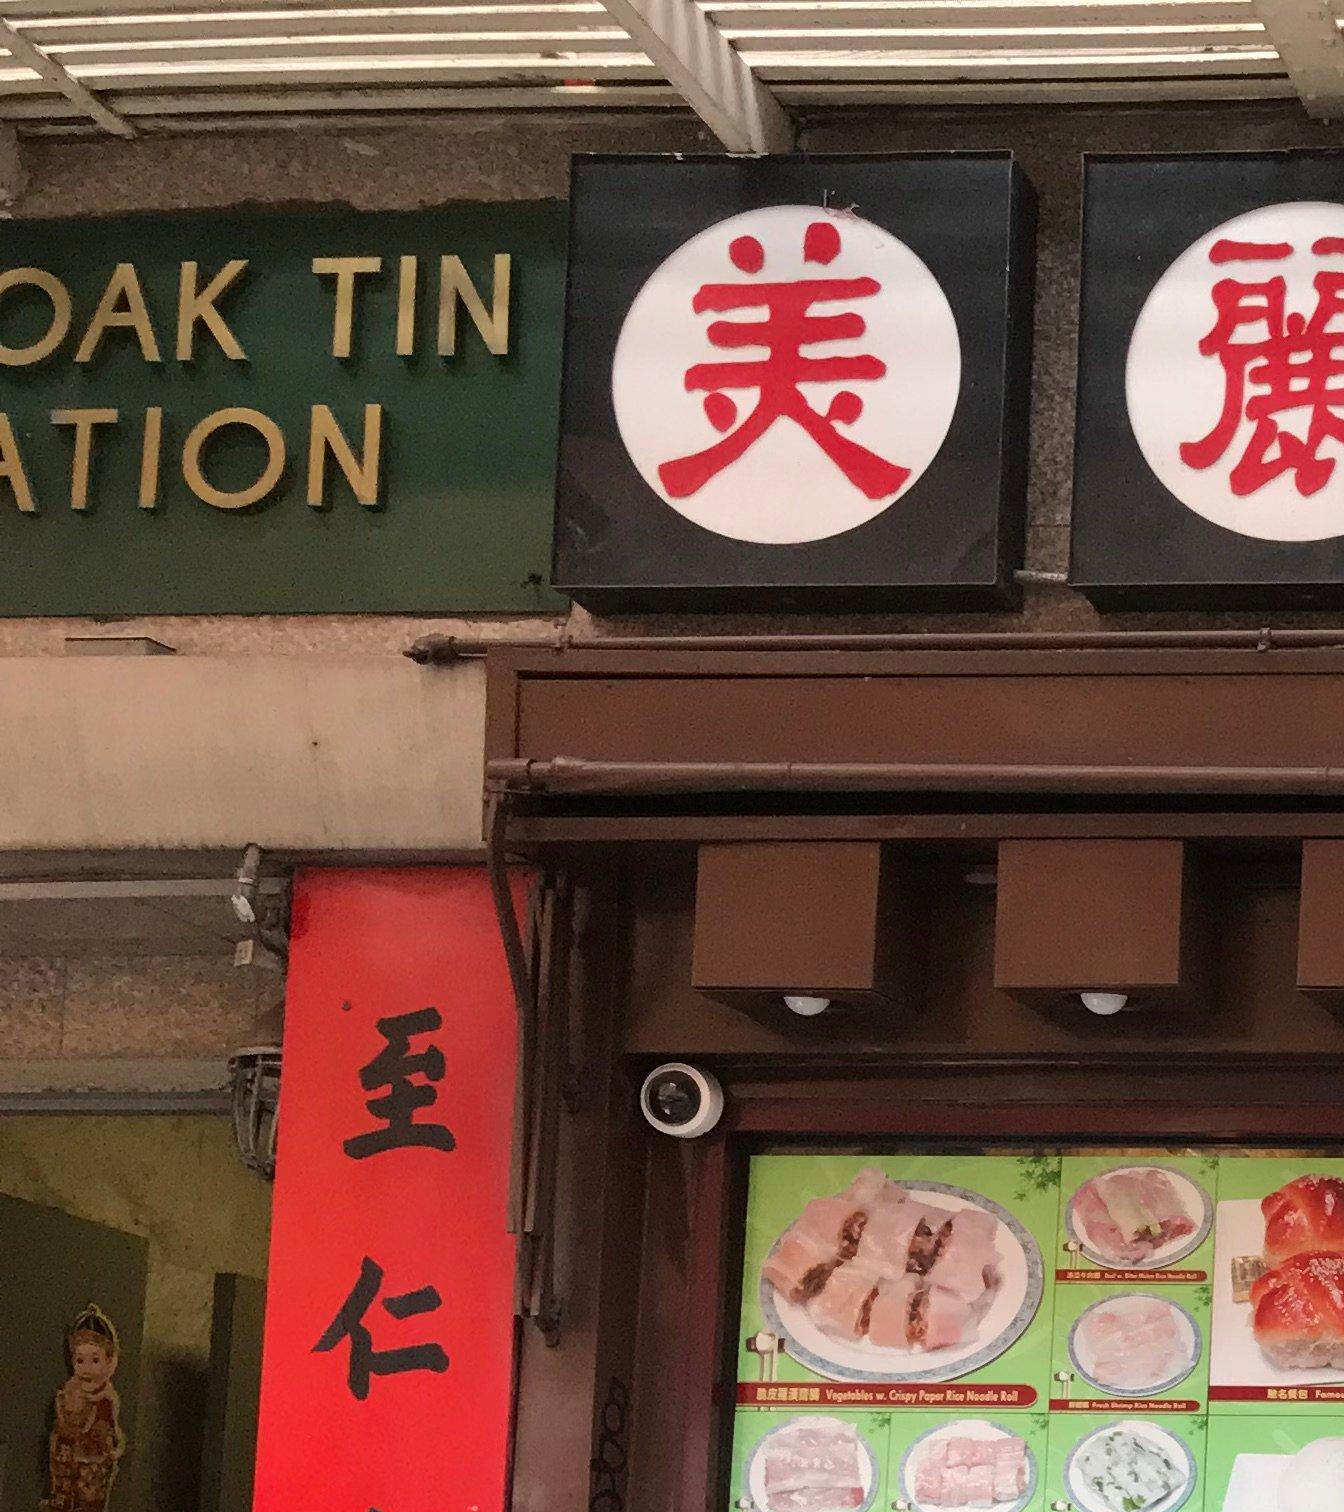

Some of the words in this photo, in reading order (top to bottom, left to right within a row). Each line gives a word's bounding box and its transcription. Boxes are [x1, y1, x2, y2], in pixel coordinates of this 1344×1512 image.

[0, 259, 250, 366] OAK
[312, 253, 511, 359] TIN
[826, 1389, 873, 1401] Vegetables
[889, 1390, 917, 1402] Crispy
[946, 1391, 964, 1401] Rice
[966, 1391, 998, 1402] Noodle
[1000, 1391, 1019, 1402] Roll
